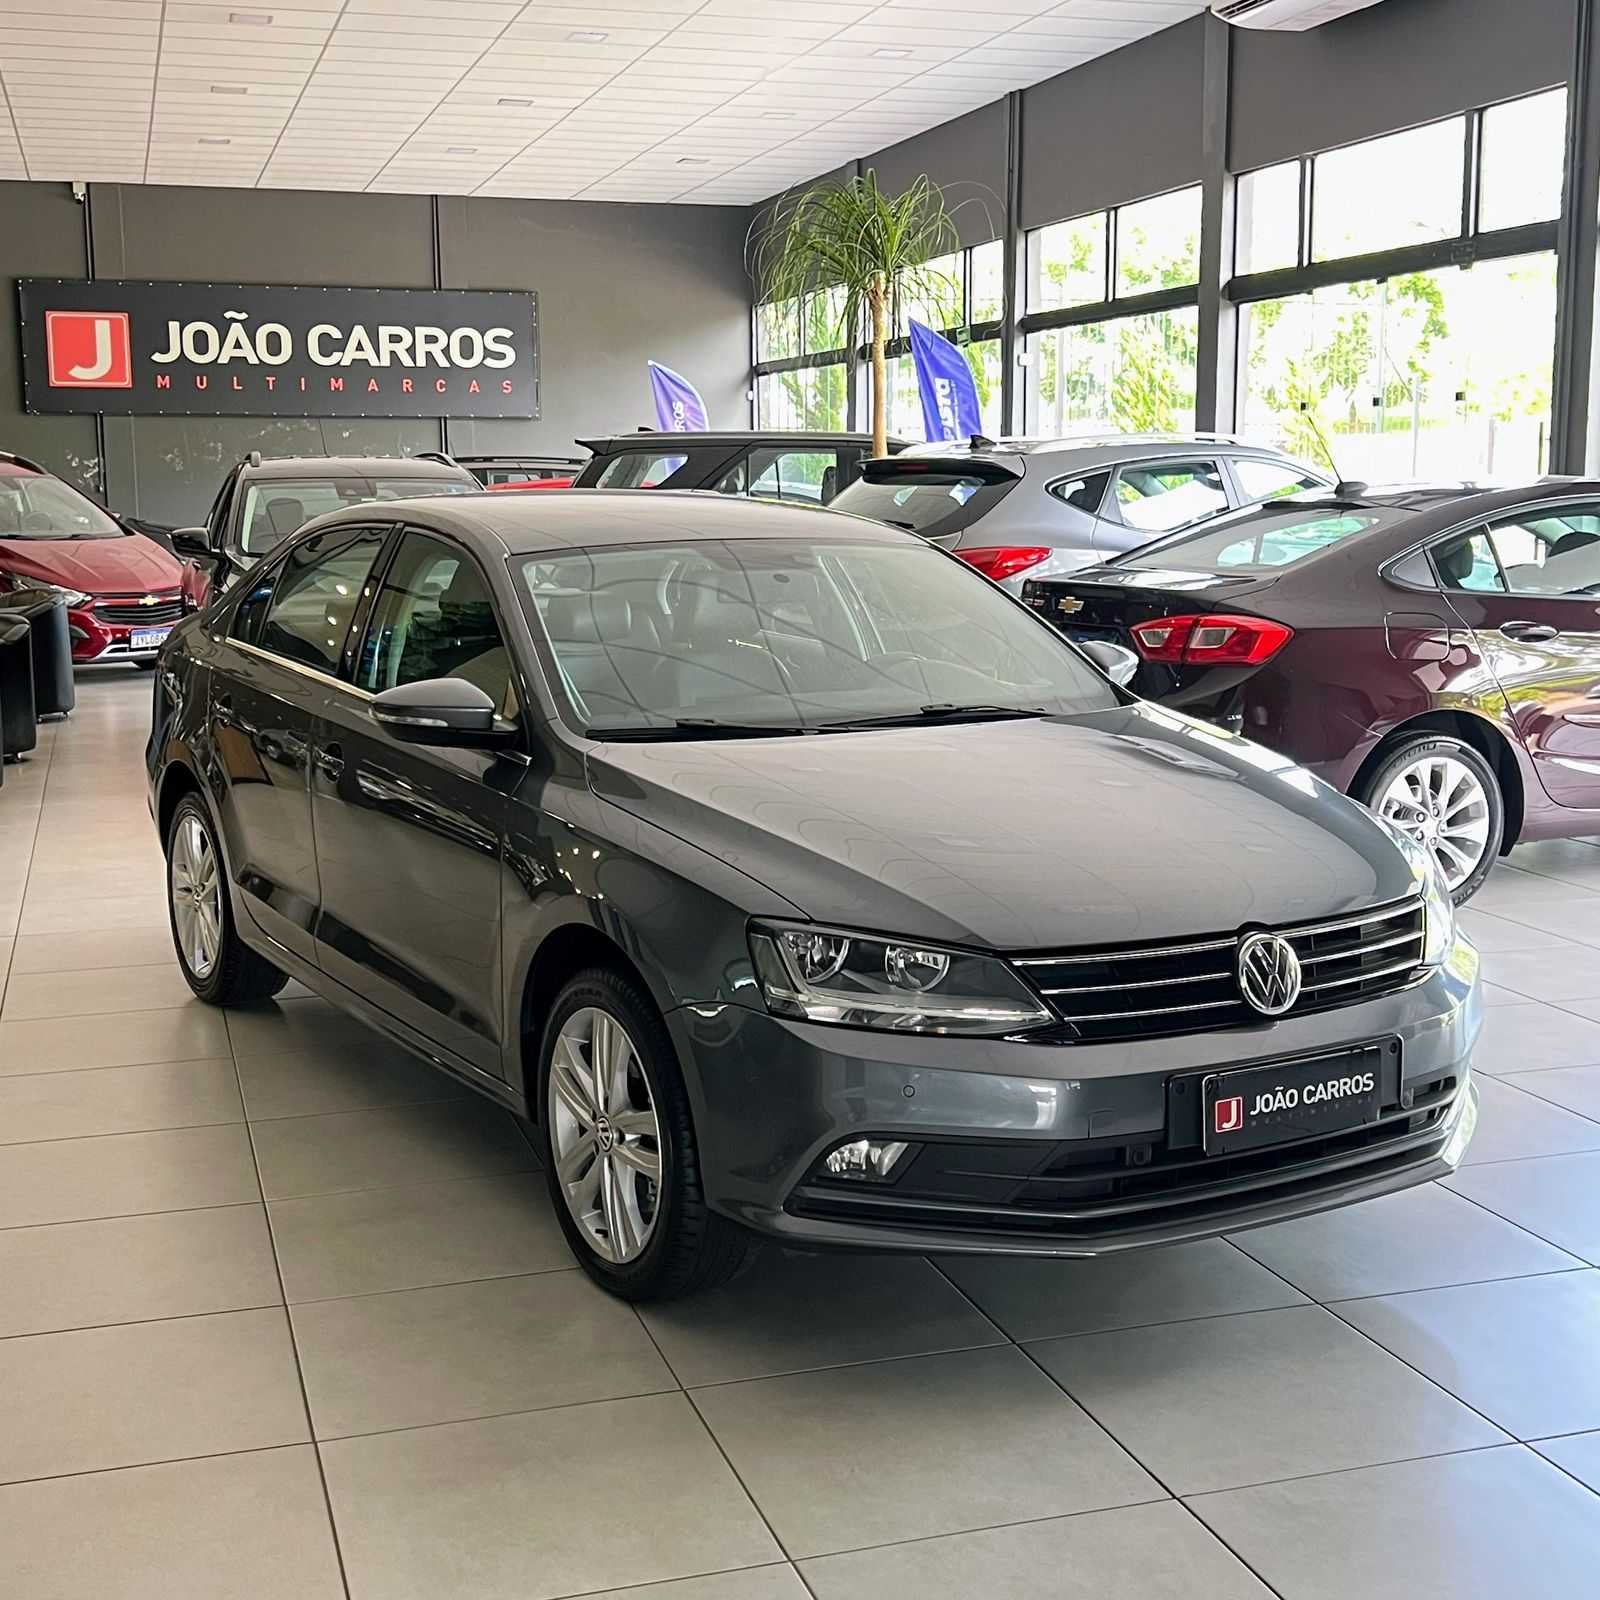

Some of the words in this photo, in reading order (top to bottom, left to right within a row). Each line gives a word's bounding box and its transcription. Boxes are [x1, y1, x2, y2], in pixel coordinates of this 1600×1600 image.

[68, 318, 111, 382] J
[150, 310, 293, 366] JOÃO
[305, 324, 517, 369] CARROS
[156, 375, 513, 394] MULTIMARCAS
[1238, 932, 1302, 1015] VW
[1221, 1099, 1236, 1129] J
[1249, 1086, 1299, 1116] JOÃO
[1302, 1072, 1375, 1105] CARROS
